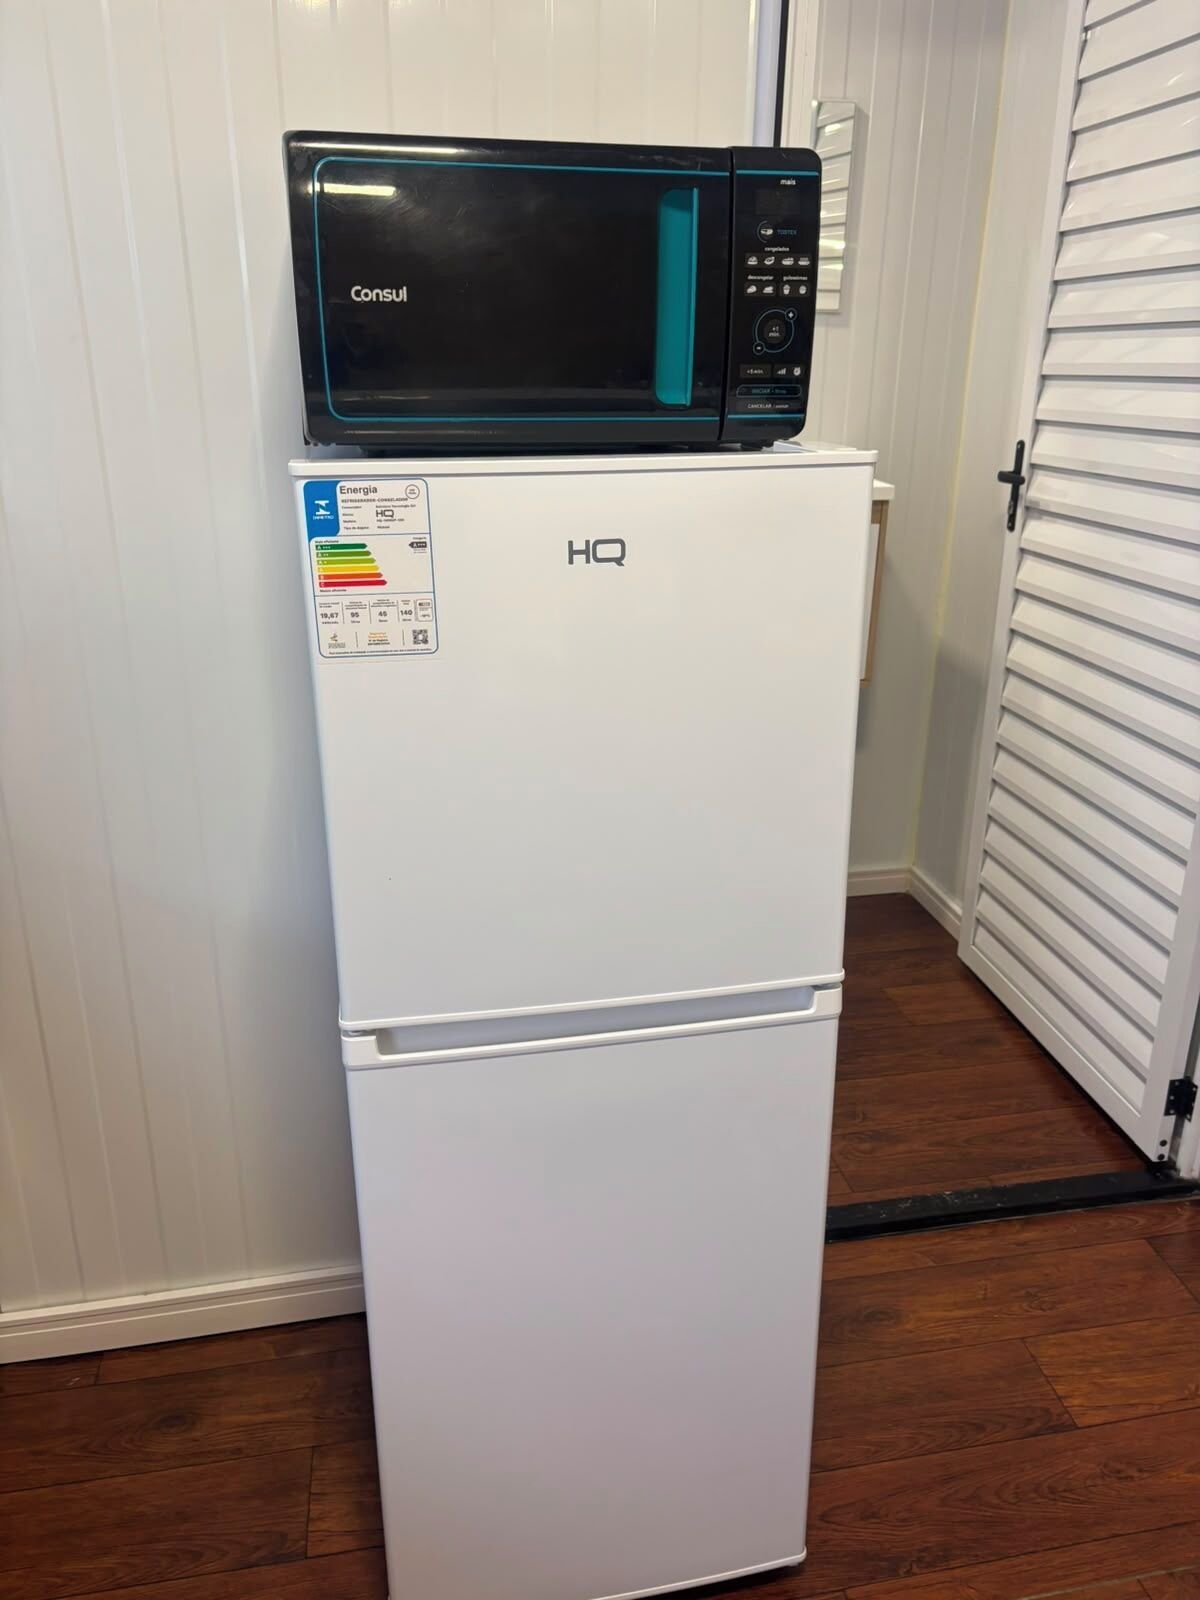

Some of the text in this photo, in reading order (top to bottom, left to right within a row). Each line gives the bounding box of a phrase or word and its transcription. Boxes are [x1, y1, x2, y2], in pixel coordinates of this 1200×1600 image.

[351, 285, 408, 302] Consul
[340, 485, 378, 496] Energia
[375, 509, 395, 518] HQ
[567, 538, 626, 567] HQ
